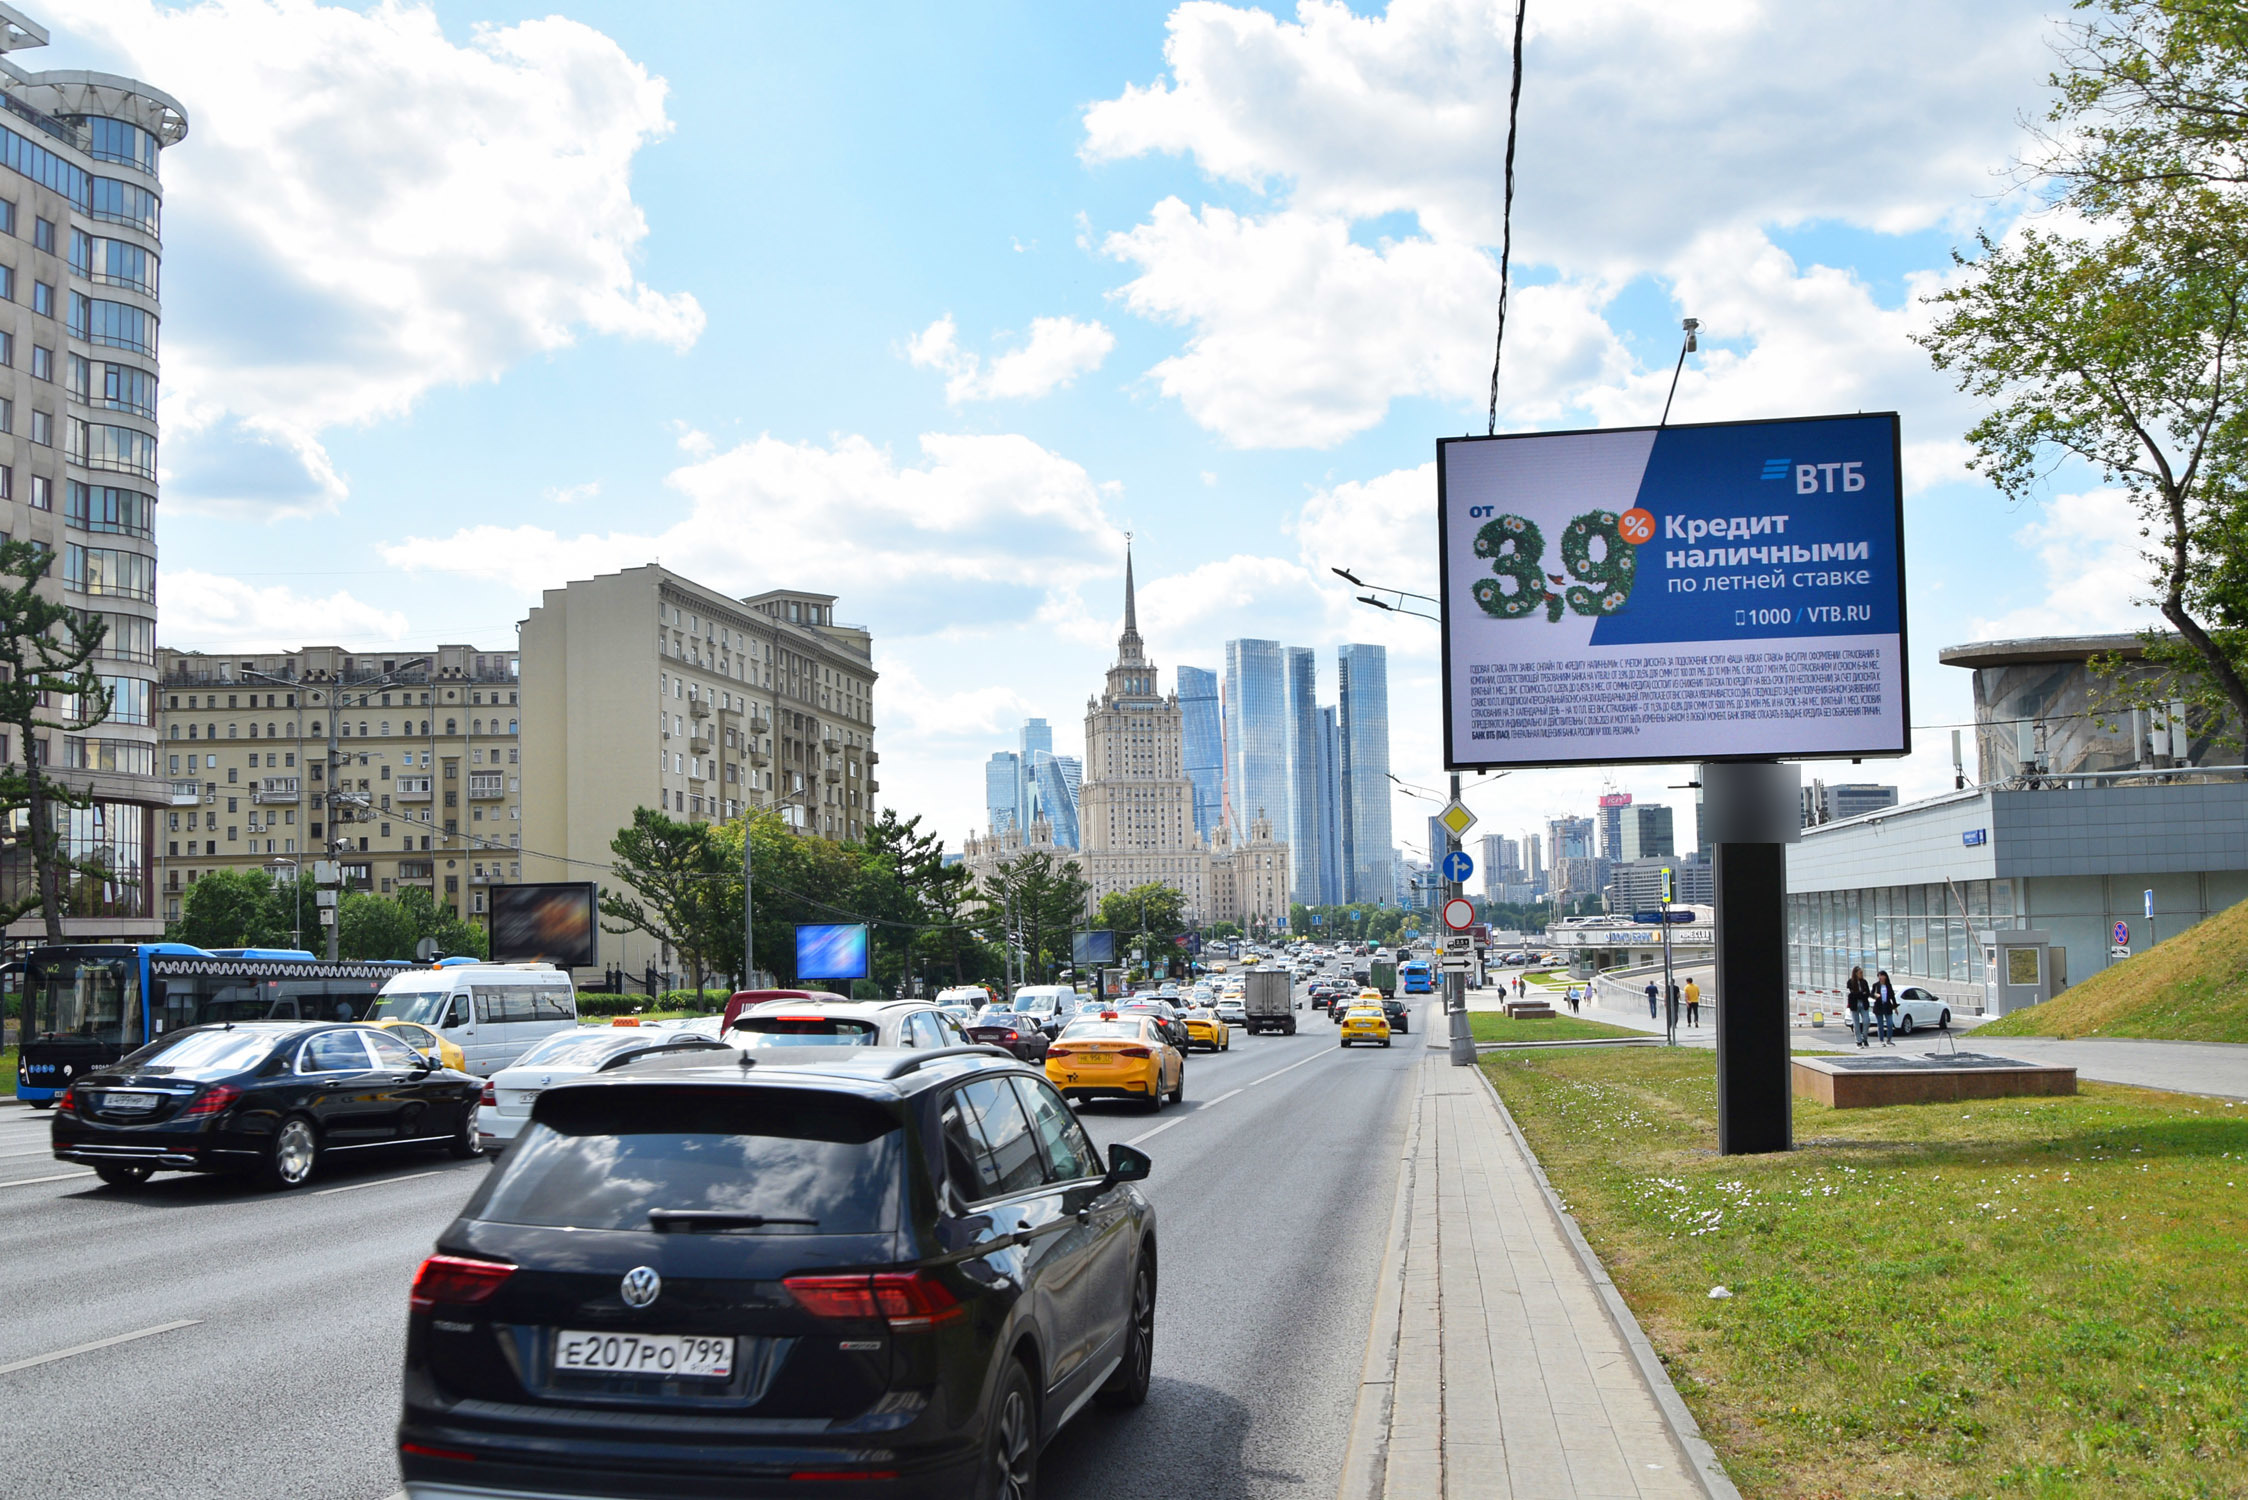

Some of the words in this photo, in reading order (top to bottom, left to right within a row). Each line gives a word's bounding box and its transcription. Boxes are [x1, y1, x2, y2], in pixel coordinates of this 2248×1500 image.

[1796, 461, 1866, 495] ВТБ
[1664, 514, 1789, 545] Кредит
[1665, 541, 1870, 569] наличными
[1668, 578, 1697, 593] по
[1702, 568, 1786, 592] летней
[1792, 569, 1871, 588] ставке
[1748, 607, 1792, 626] 1000
[1807, 604, 1871, 623] VTB.RU
